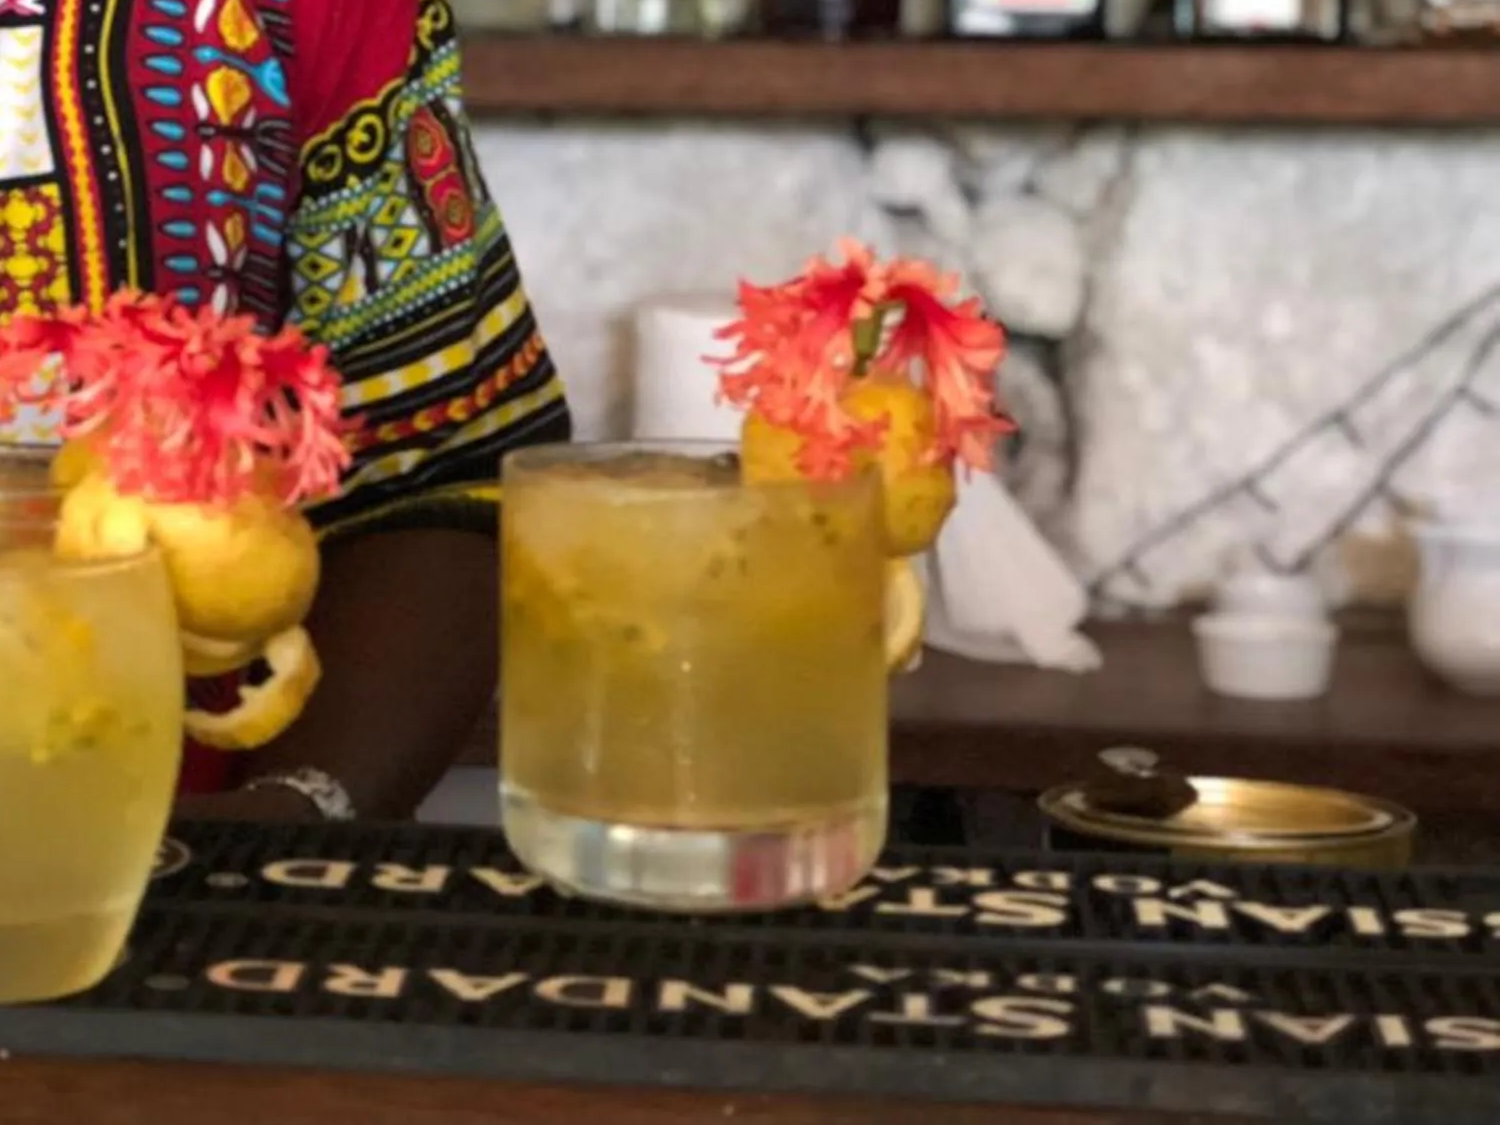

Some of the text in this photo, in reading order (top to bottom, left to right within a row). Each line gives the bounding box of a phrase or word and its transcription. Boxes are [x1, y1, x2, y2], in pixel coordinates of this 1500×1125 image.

[871, 866, 1237, 899] VODKA
[205, 959, 1076, 1039] STANDARD
[849, 964, 1260, 1002] VODKA
